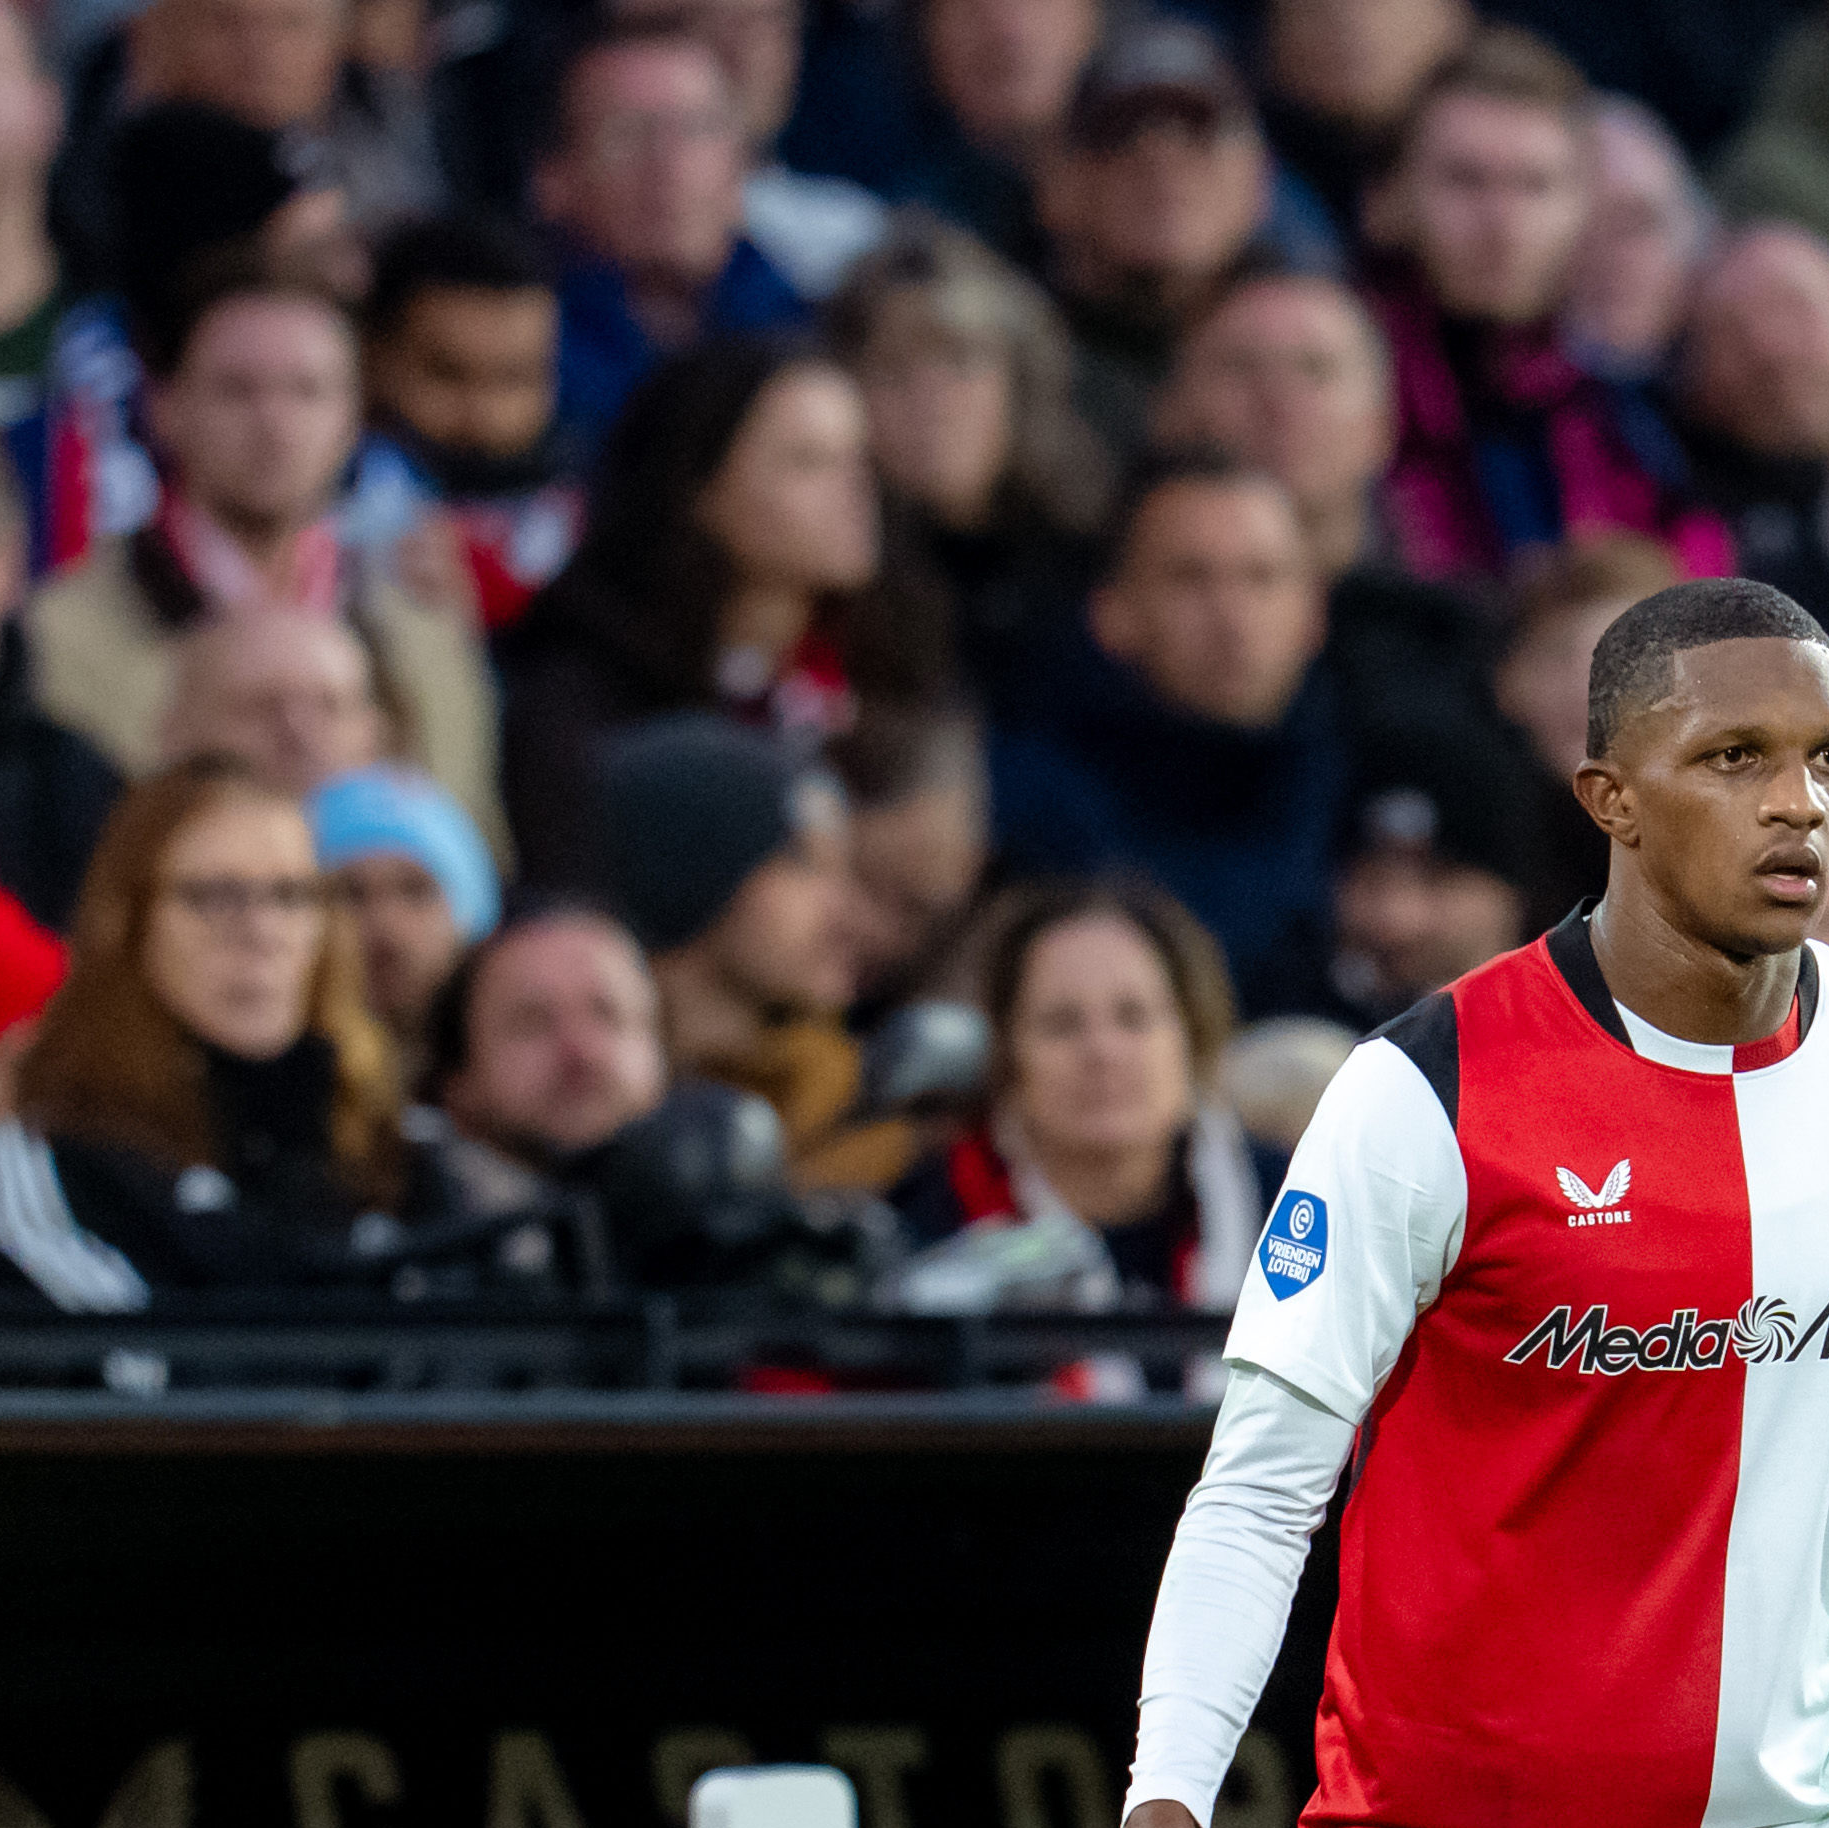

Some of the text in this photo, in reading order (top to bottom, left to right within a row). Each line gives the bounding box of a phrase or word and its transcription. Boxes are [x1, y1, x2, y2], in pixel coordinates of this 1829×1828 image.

[1567, 1210, 1632, 1228] CASTORE
[1268, 1238, 1322, 1269] VRIENDEN
[1267, 1256, 1311, 1284] LOTERIJ
[1504, 1304, 1733, 1376] Media
